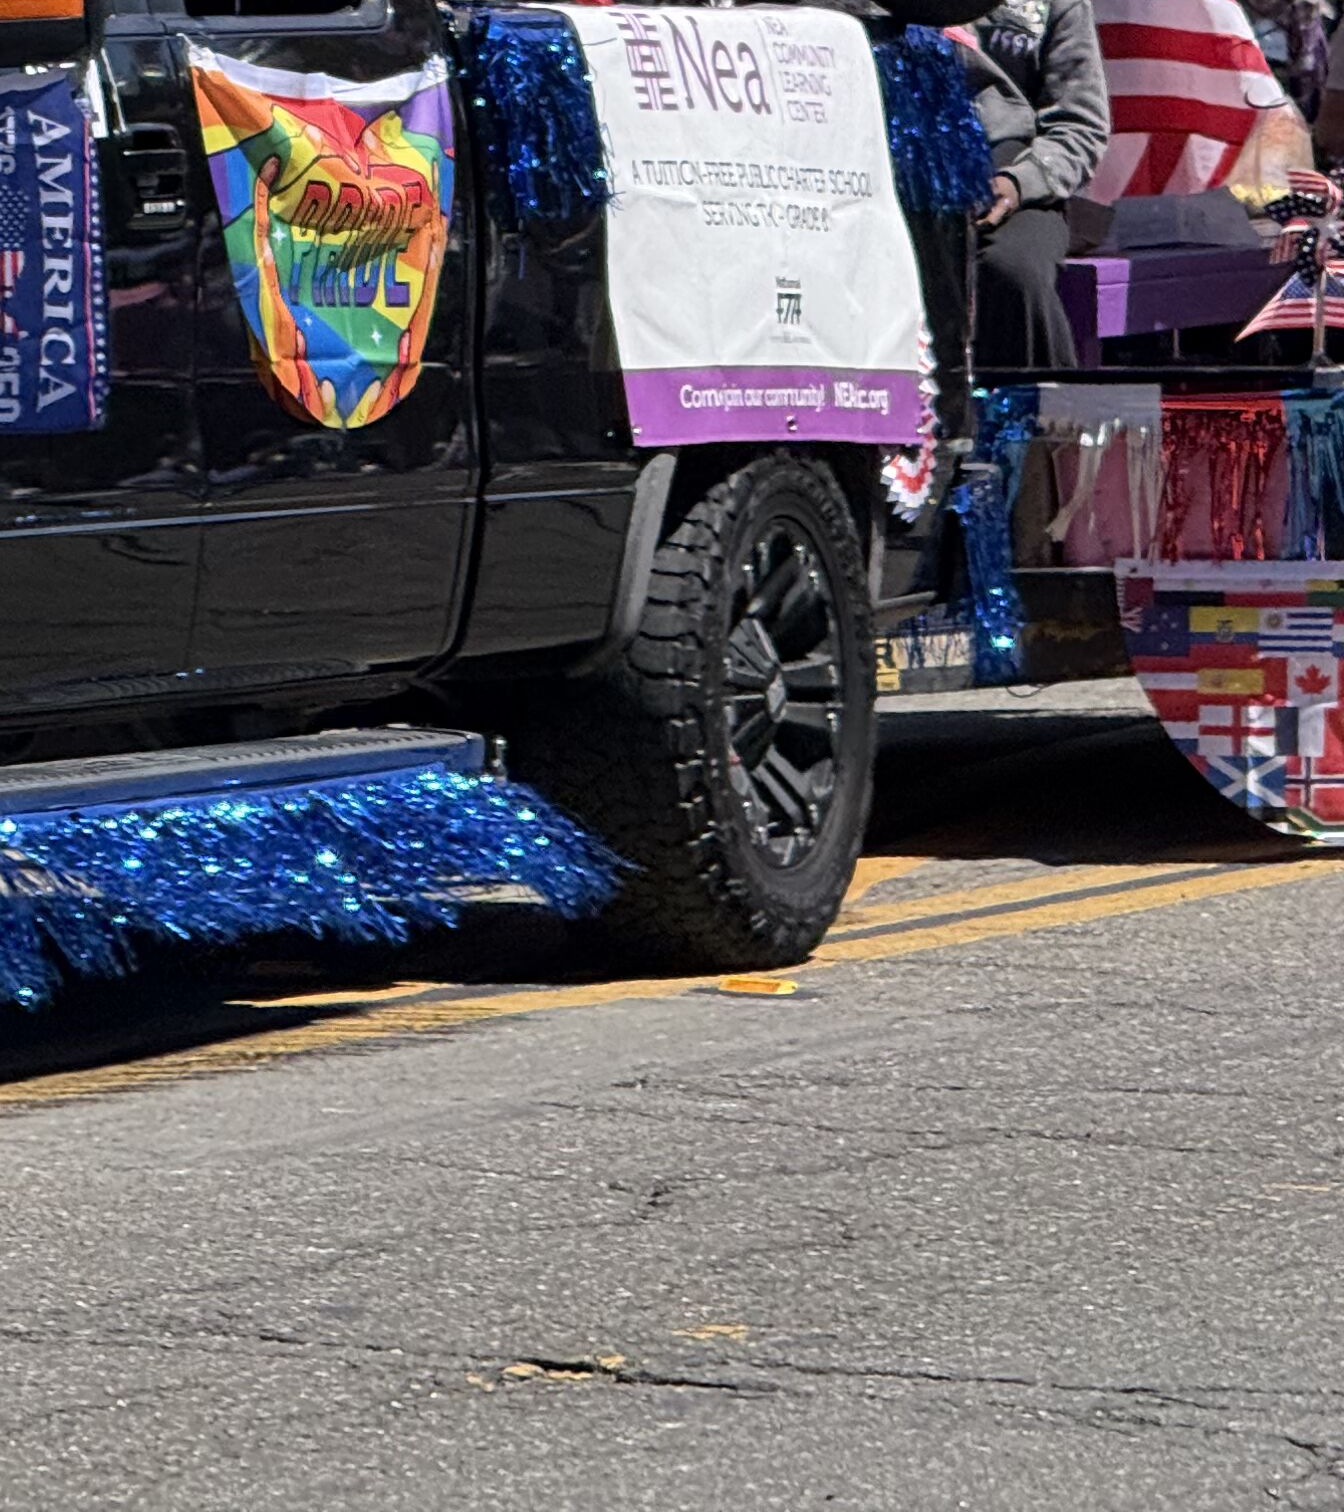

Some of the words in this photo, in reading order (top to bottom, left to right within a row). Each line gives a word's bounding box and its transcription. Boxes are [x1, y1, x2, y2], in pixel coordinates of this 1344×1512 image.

[664, 14, 774, 115] Nea
[632, 160, 642, 185] A
[827, 169, 873, 198] SCHOOL
[26, 109, 78, 414] AMERICA
